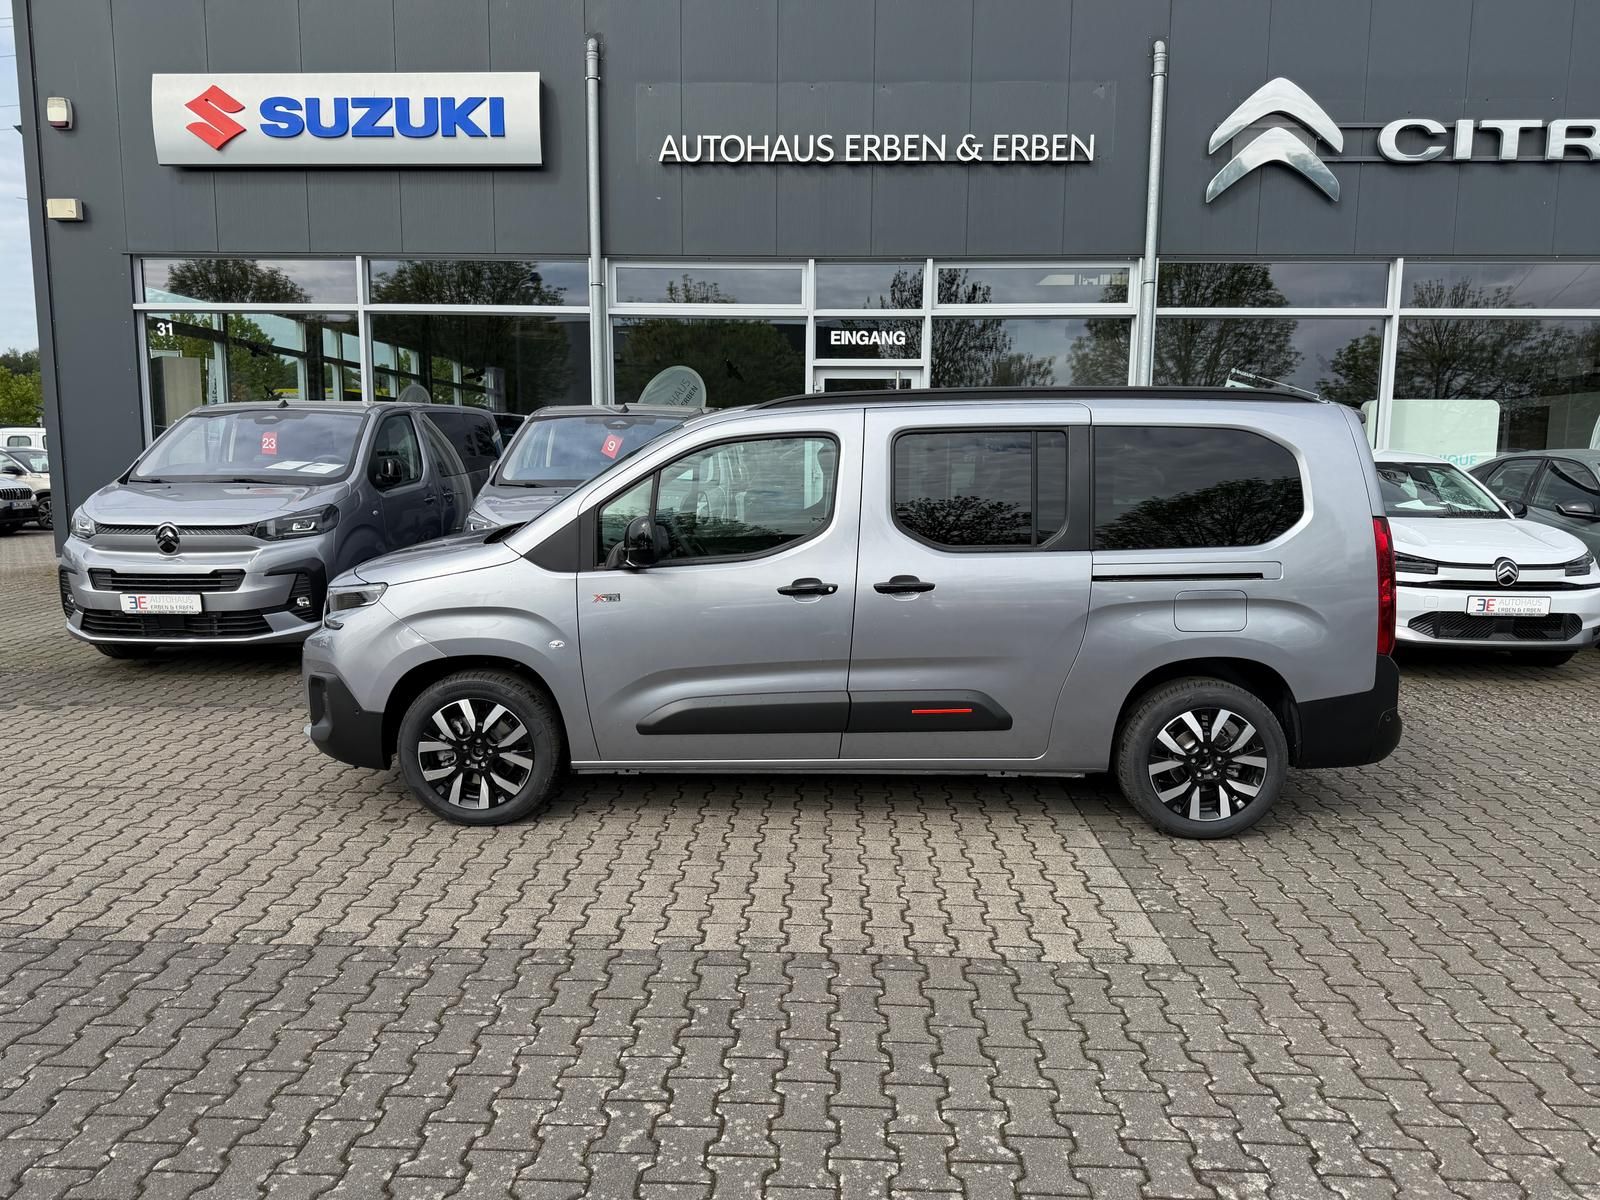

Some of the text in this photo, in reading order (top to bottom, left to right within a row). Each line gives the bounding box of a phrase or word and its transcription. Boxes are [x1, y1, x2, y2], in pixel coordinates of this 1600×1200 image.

[259, 96, 506, 138] SUZUKI
[658, 133, 1095, 163] AUTOHAUS ERBEN & ERBEN
[156, 322, 174, 337] 31
[830, 330, 906, 346] EINGANG
[262, 437, 276, 449] 23
[607, 440, 616, 452] 9
